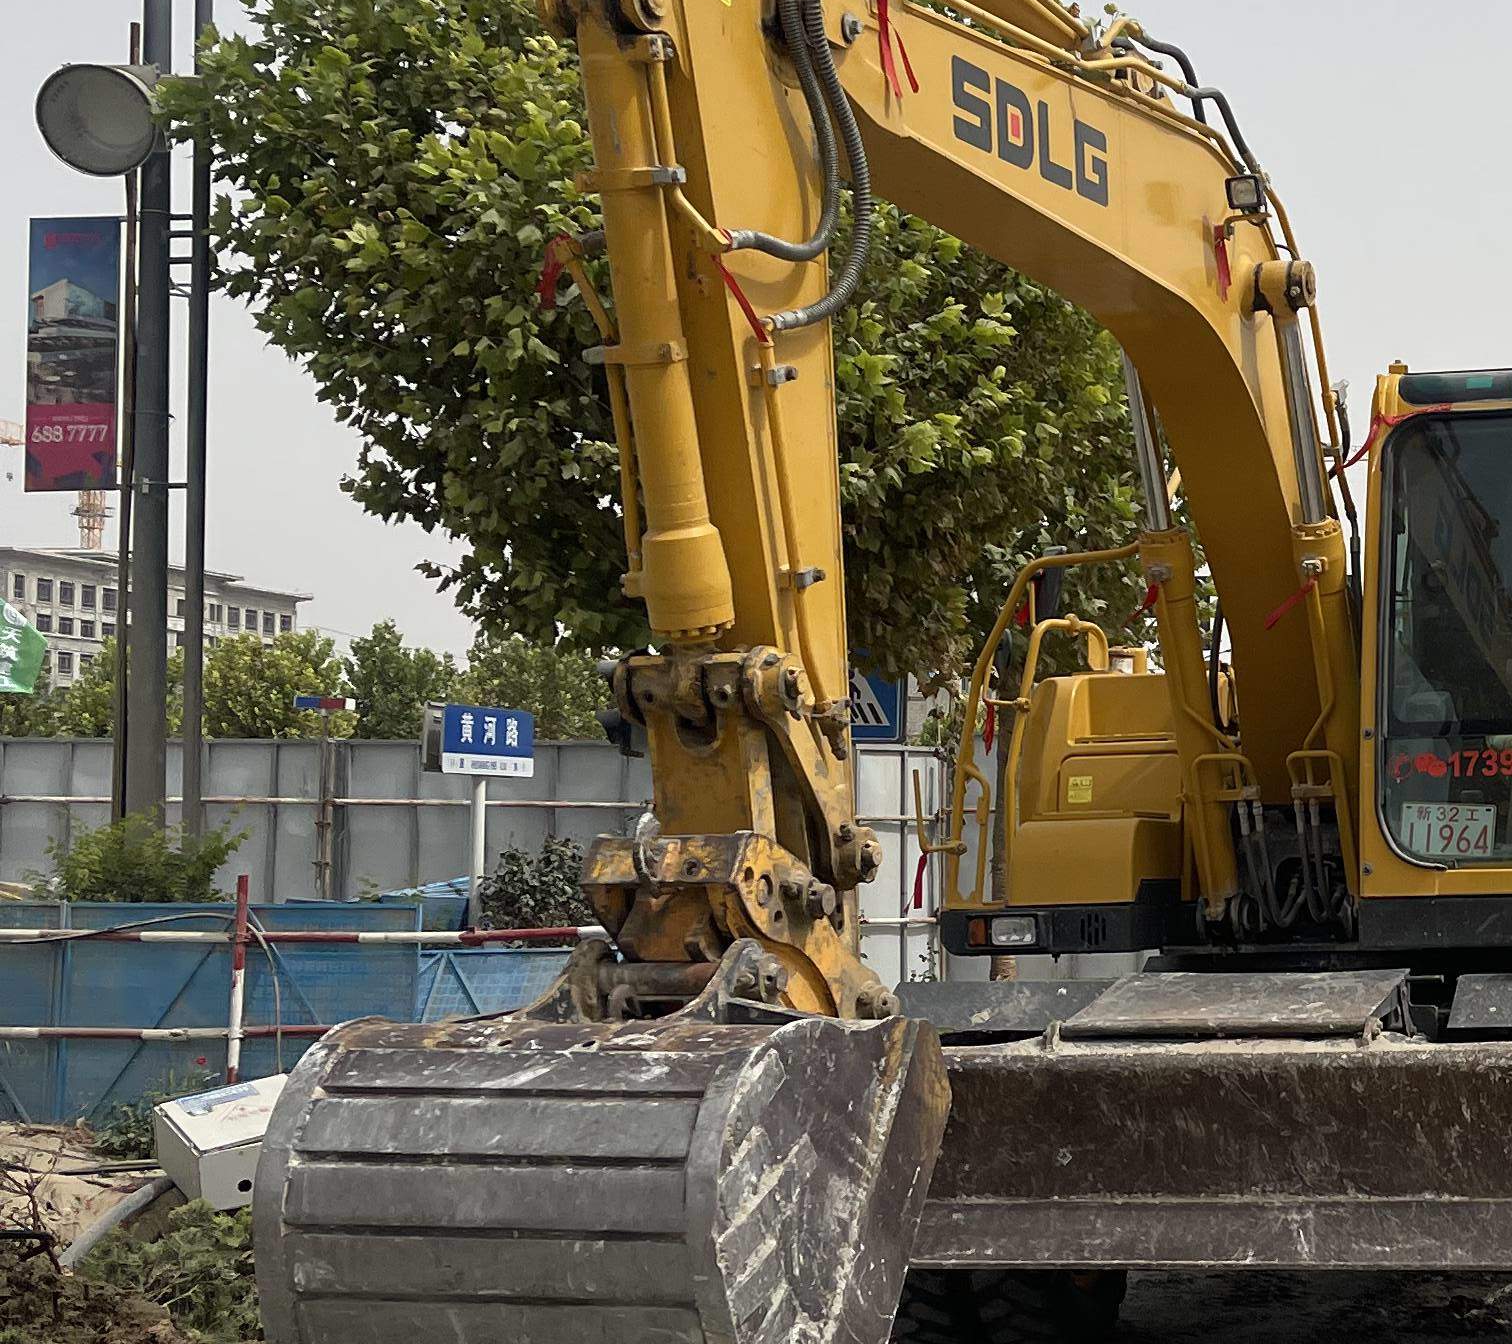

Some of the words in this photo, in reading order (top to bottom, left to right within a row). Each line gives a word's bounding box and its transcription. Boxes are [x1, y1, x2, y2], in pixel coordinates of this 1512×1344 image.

[952, 54, 1109, 208] SDLG
[31, 424, 64, 443] 688
[66, 424, 108, 442] 7777
[460, 712, 519, 748] 黄河路
[1408, 822, 1489, 854] 11964
